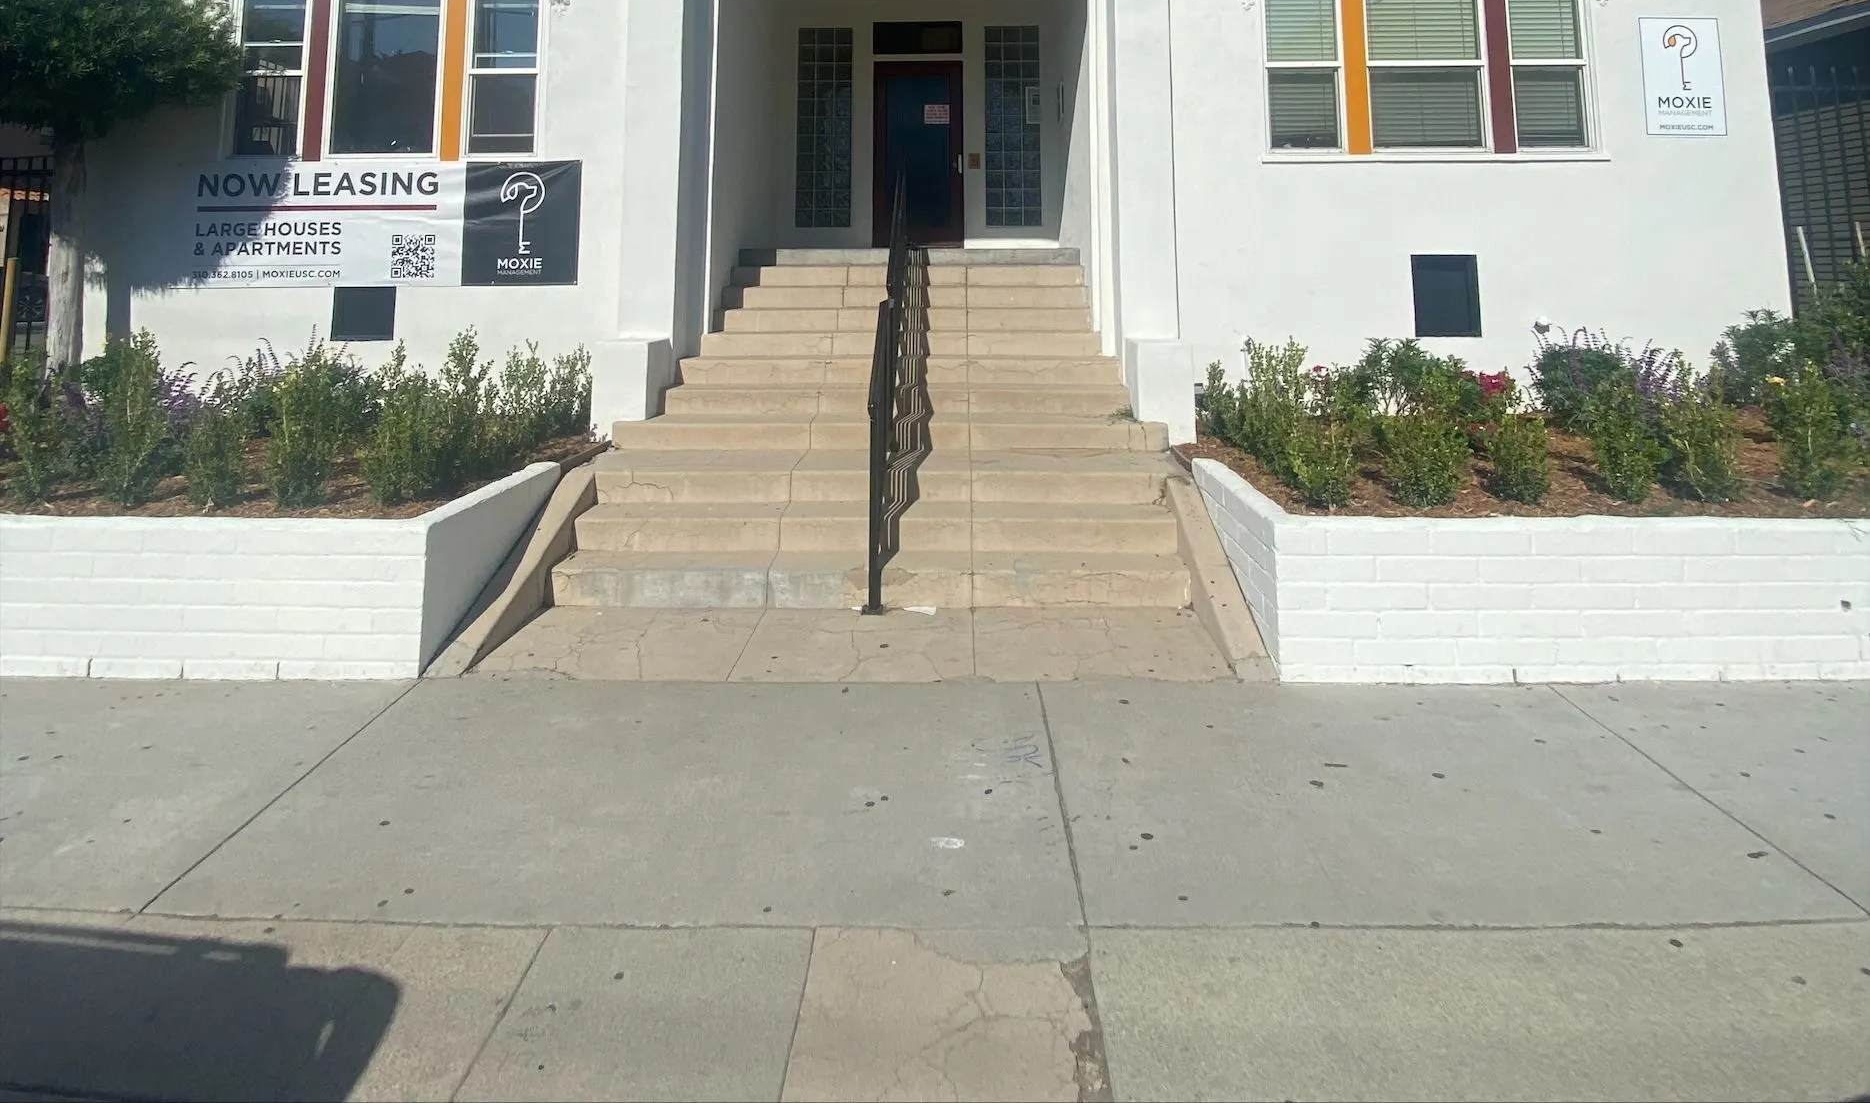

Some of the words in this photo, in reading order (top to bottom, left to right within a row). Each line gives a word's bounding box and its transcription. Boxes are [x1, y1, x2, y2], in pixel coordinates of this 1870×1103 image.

[1658, 96, 1712, 109] MOXIE
[197, 173, 281, 197] NOW
[293, 172, 439, 196] LEASING
[195, 222, 258, 237] LARGE
[264, 222, 342, 237] HOUSES
[193, 242, 205, 256] &
[211, 241, 342, 256] APARTMENTS
[497, 258, 543, 269] MOXIE
[191, 270, 253, 279] 310.362.8105
[262, 270, 341, 279] MOXIEUSC.COM
